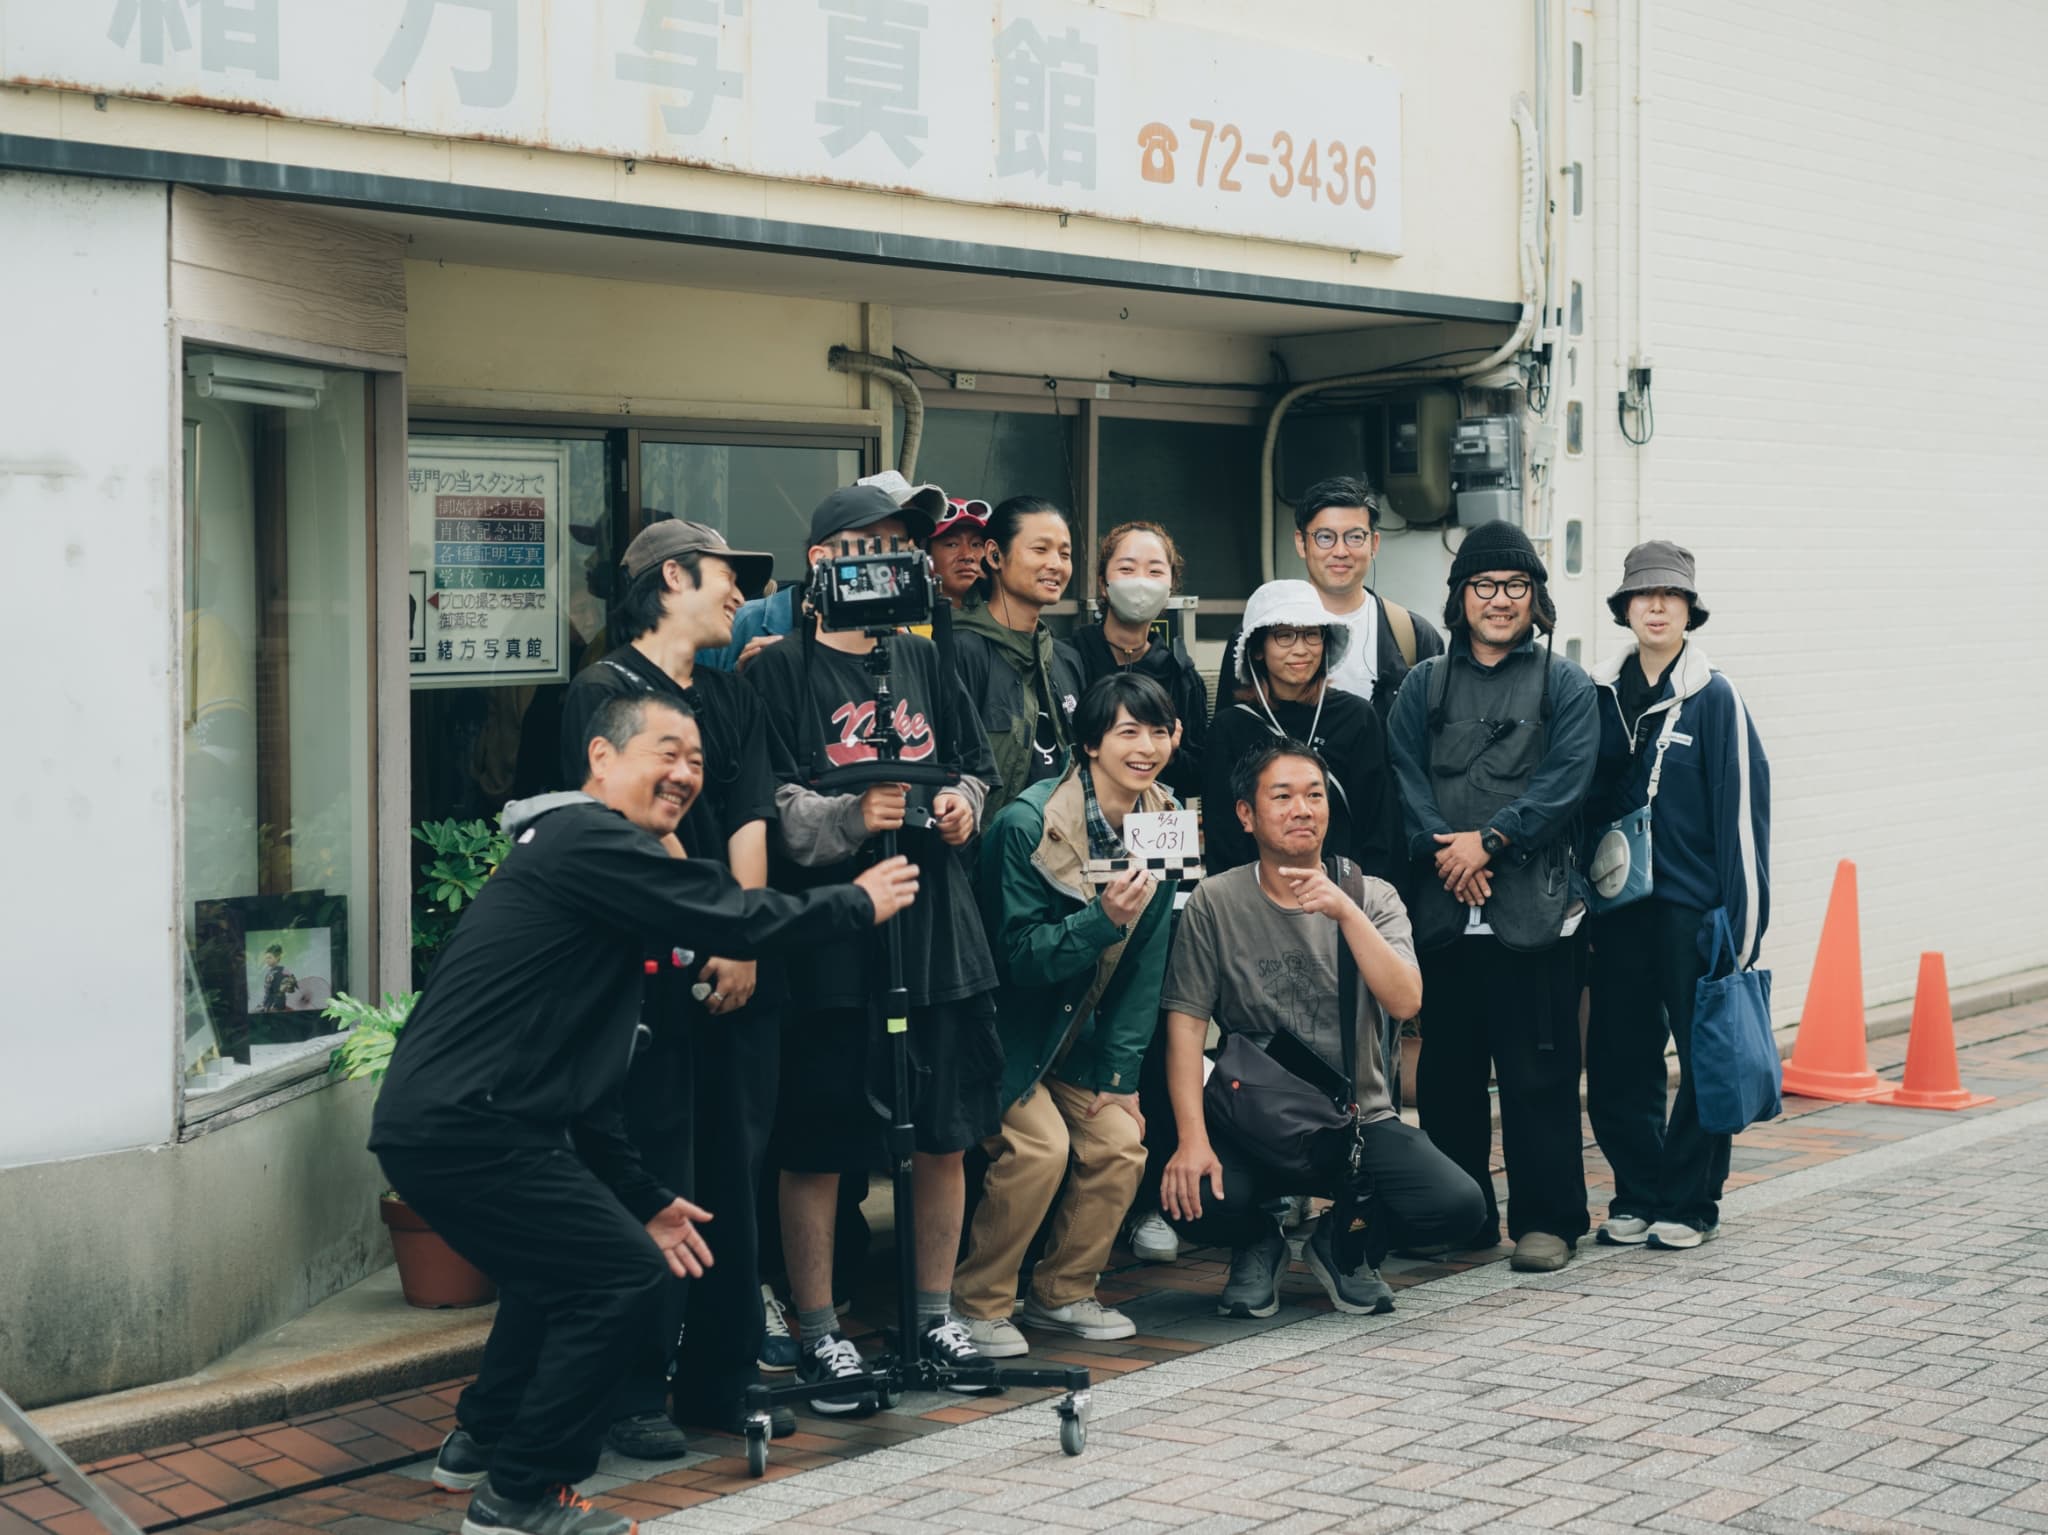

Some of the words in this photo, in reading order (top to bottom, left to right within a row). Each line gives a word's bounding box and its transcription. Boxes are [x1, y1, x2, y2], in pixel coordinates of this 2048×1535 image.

[1189, 118, 1377, 211] 72-3436
[440, 544, 543, 564] 各種証明写真
[439, 567, 542, 588] 学校アルバム
[438, 637, 543, 660] 緒方写真館
[826, 698, 935, 762] Nke
[1131, 828, 1185, 851] R-031
